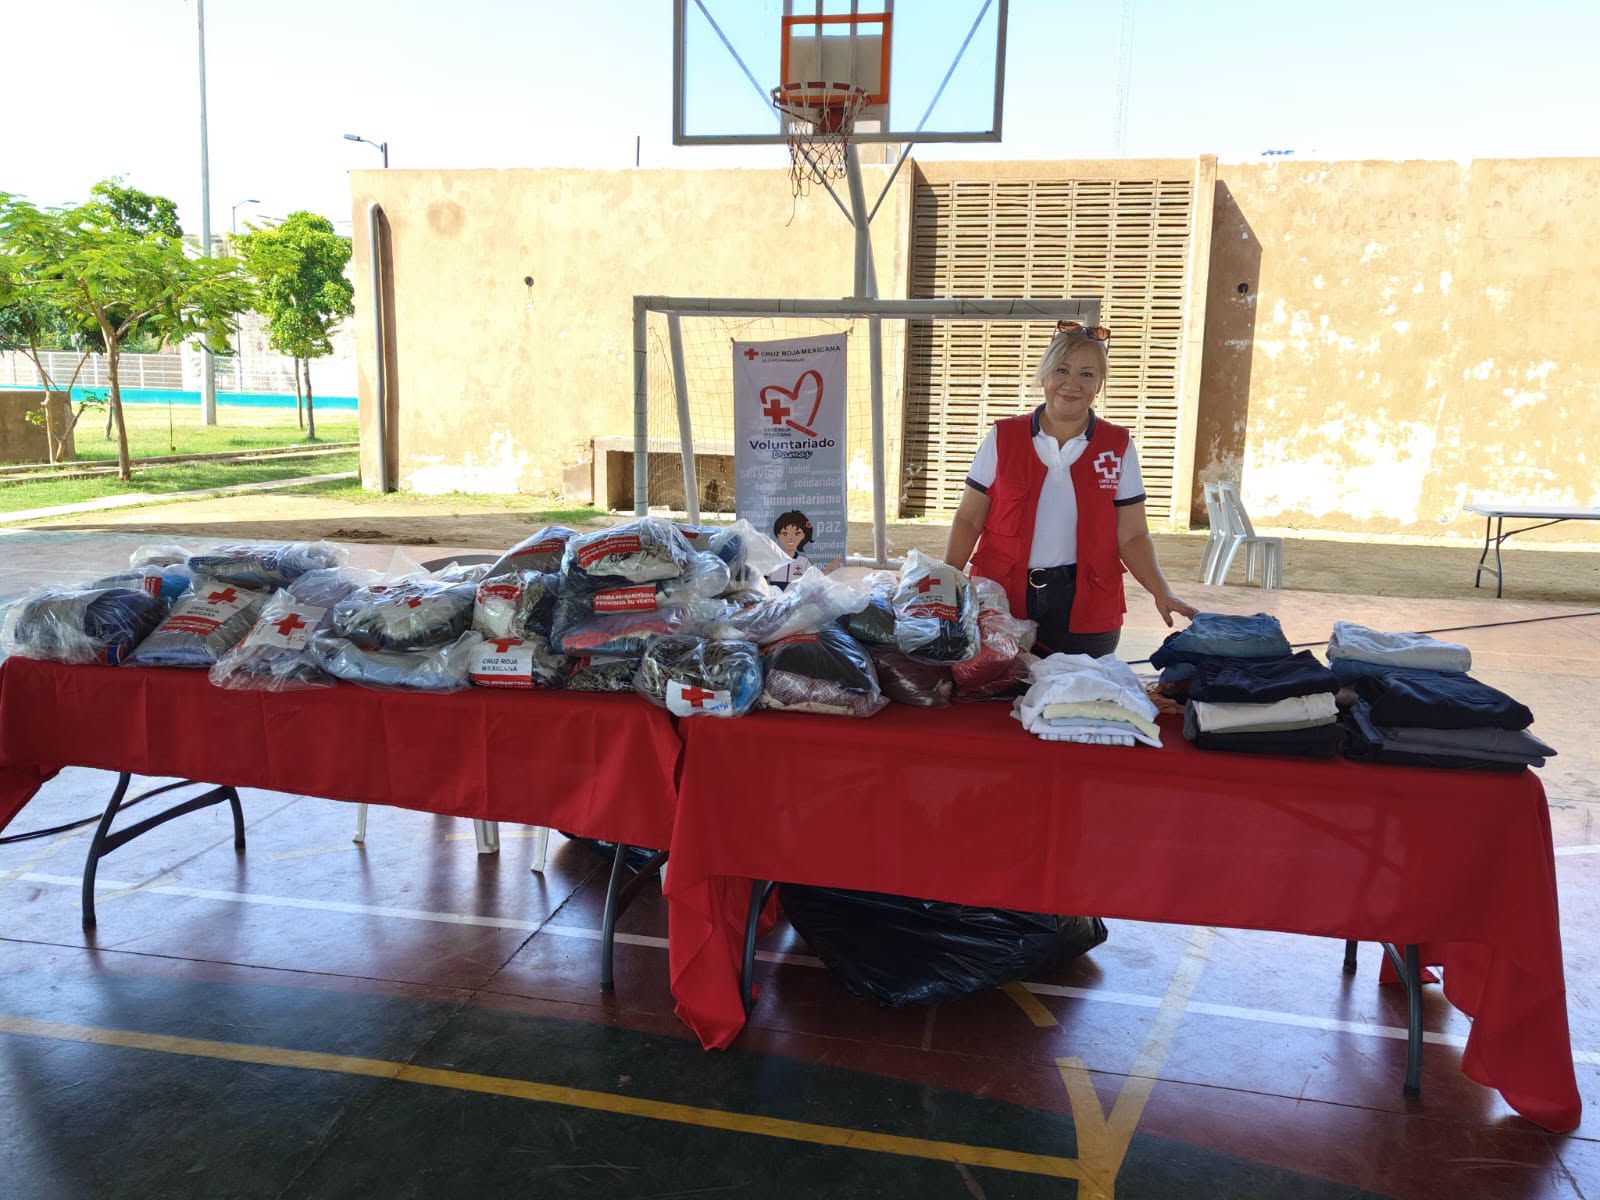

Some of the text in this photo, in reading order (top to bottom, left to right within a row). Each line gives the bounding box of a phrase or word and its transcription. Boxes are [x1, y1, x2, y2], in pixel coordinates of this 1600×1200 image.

[801, 345, 841, 354] MEXICANA
[750, 438, 835, 450] Voluntariado
[763, 493, 841, 506] humanitarismo
[816, 520, 841, 537] paz
[812, 541, 844, 551] dignidad
